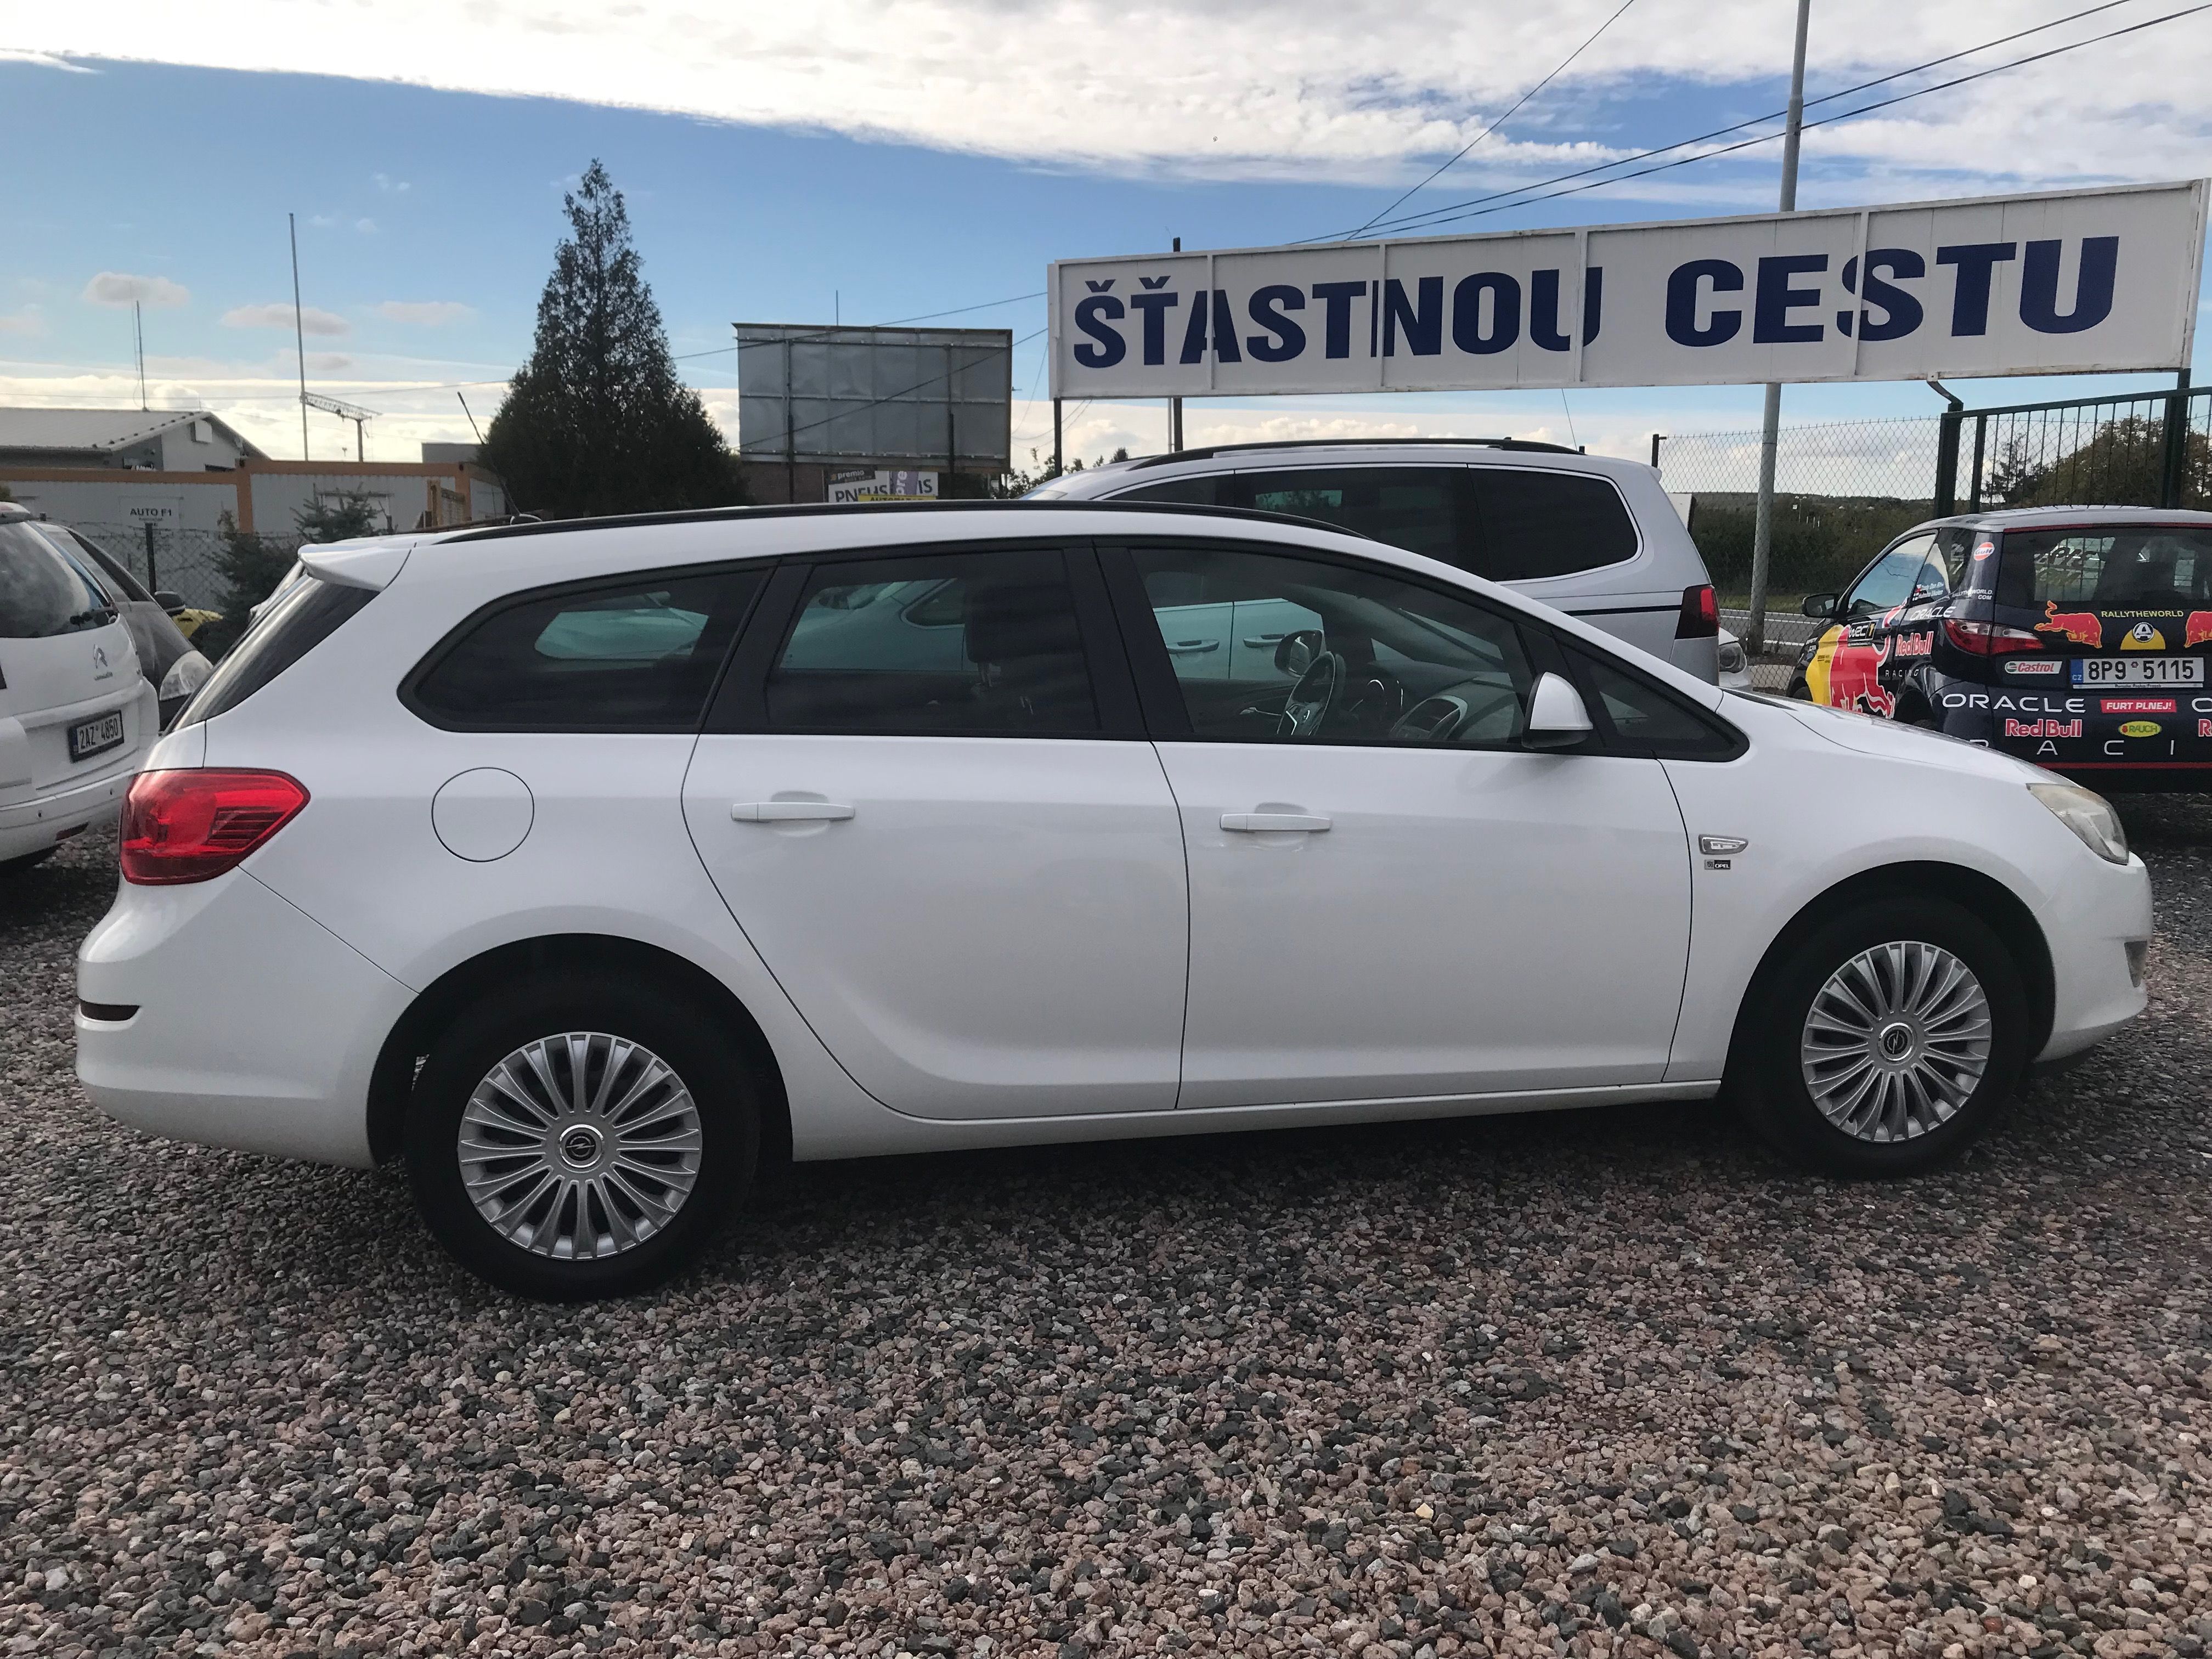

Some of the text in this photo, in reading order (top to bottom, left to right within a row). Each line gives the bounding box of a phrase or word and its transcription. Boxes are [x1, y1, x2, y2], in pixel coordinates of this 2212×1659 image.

[1074, 236, 2119, 368] ŠŤASTNOU CESTU
[130, 508, 158, 516] AUTO
[1910, 606, 1956, 620] ORACLE
[1895, 631, 1934, 656] Red Bull
[1885, 669, 1919, 678] RACING
[2018, 662, 2055, 672] Castrol
[2088, 660, 2193, 680] 8P9 5115
[1942, 693, 2086, 713] ORACLE
[2136, 702, 2172, 710] PLNEJ!
[80, 718, 119, 749] 2AZ 4850
[2005, 719, 2082, 737] Red Bull
[2129, 725, 2158, 733] RAUCH
